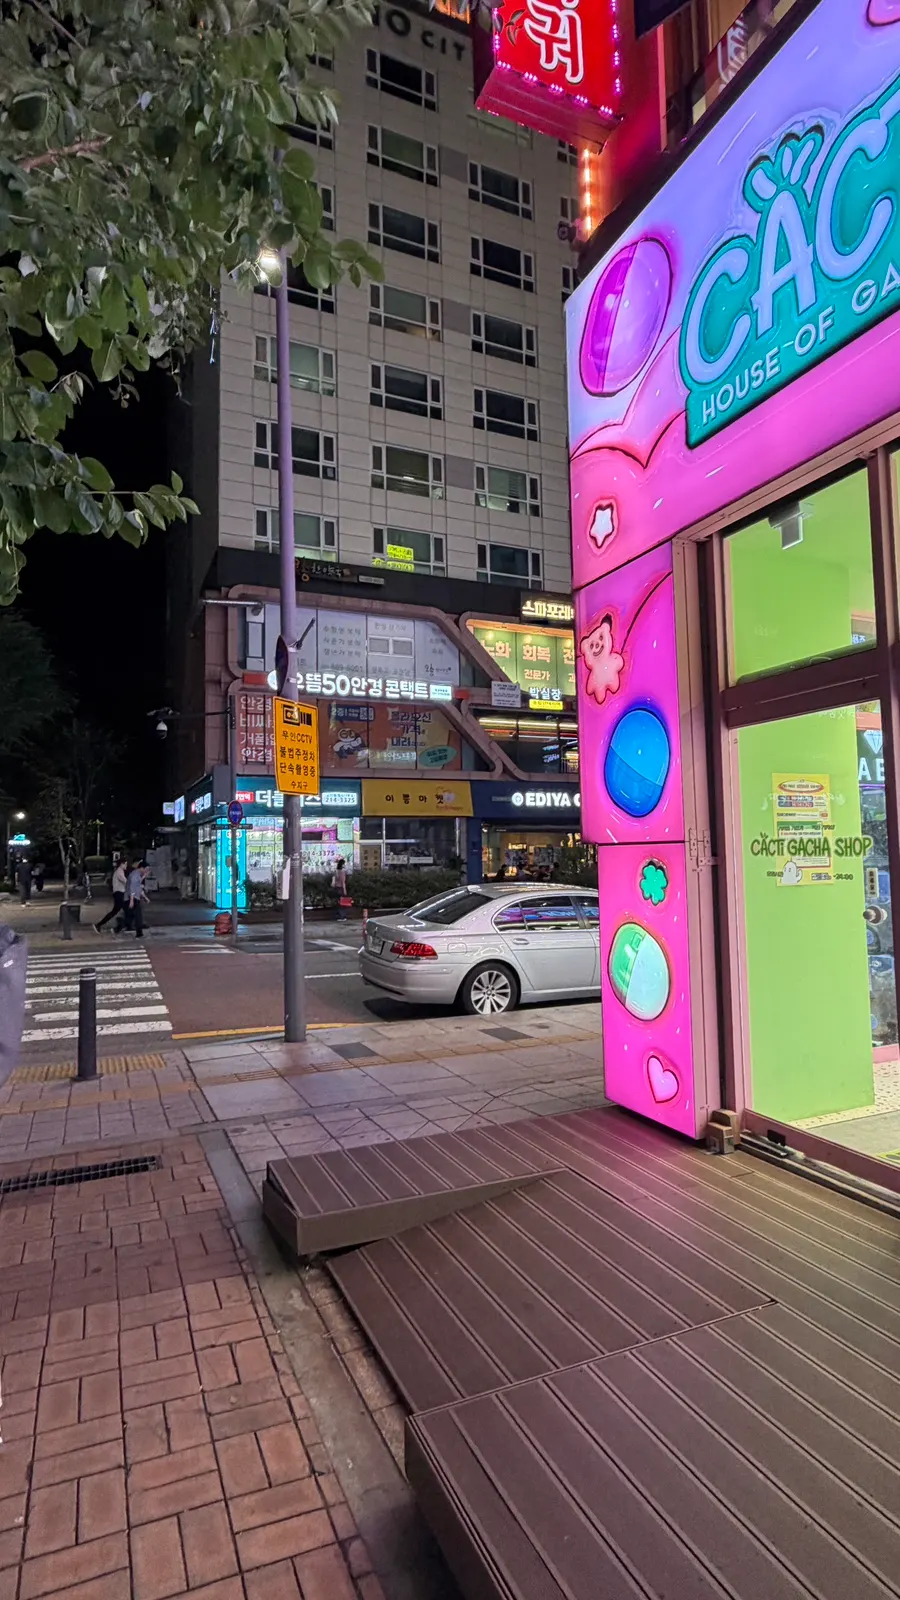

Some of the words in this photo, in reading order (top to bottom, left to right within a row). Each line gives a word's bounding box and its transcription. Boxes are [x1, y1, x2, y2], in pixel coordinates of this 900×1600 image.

[702, 350, 781, 426] HOUSE
[794, 304, 835, 357] OF
[522, 644, 551, 663] 회복
[523, 668, 551, 681] 전문가
[385, 678, 429, 700] 콘택트
[529, 686, 562, 701] 박실장
[282, 730, 313, 745] 무인CCTV
[279, 746, 315, 762] 불법주정차
[279, 762, 316, 778] 단속촬영중
[290, 780, 309, 790] 수지구
[255, 789, 322, 808] 더블스
[525, 792, 571, 807] EDIYA
[787, 836, 831, 858] GACHA
[834, 836, 872, 857] SHOP
